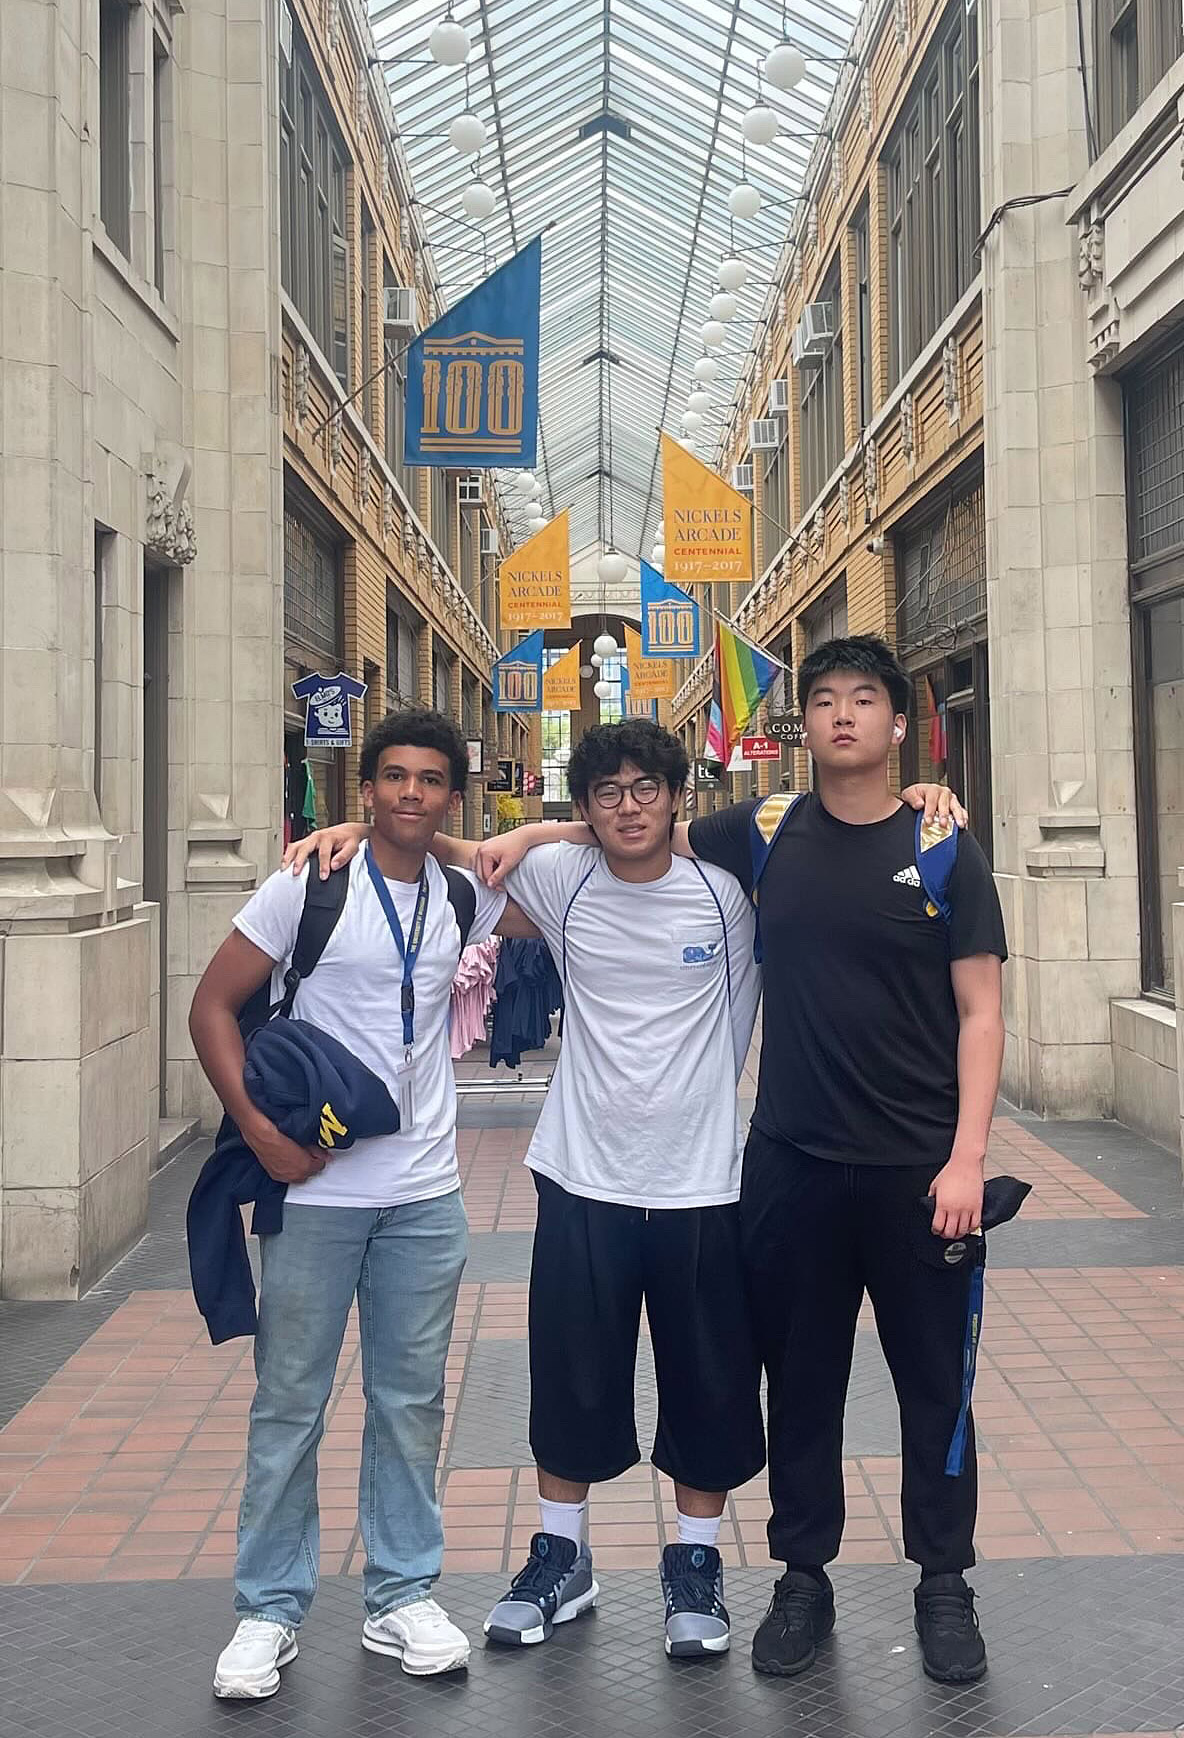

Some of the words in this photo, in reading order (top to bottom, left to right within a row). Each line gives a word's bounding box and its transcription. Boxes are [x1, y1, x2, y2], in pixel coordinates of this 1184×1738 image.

[421, 359, 524, 435] 100
[673, 508, 742, 523] NICKELS
[675, 527, 742, 541] ARCADE
[673, 547, 742, 555] CENTENNIAL
[508, 570, 562, 582] NICKELS
[508, 585, 562, 597] ARCADE
[507, 601, 562, 609] CENTENNIAL
[648, 610, 693, 645] 100
[772, 723, 804, 733] COM
[753, 741, 768, 750] A-1
